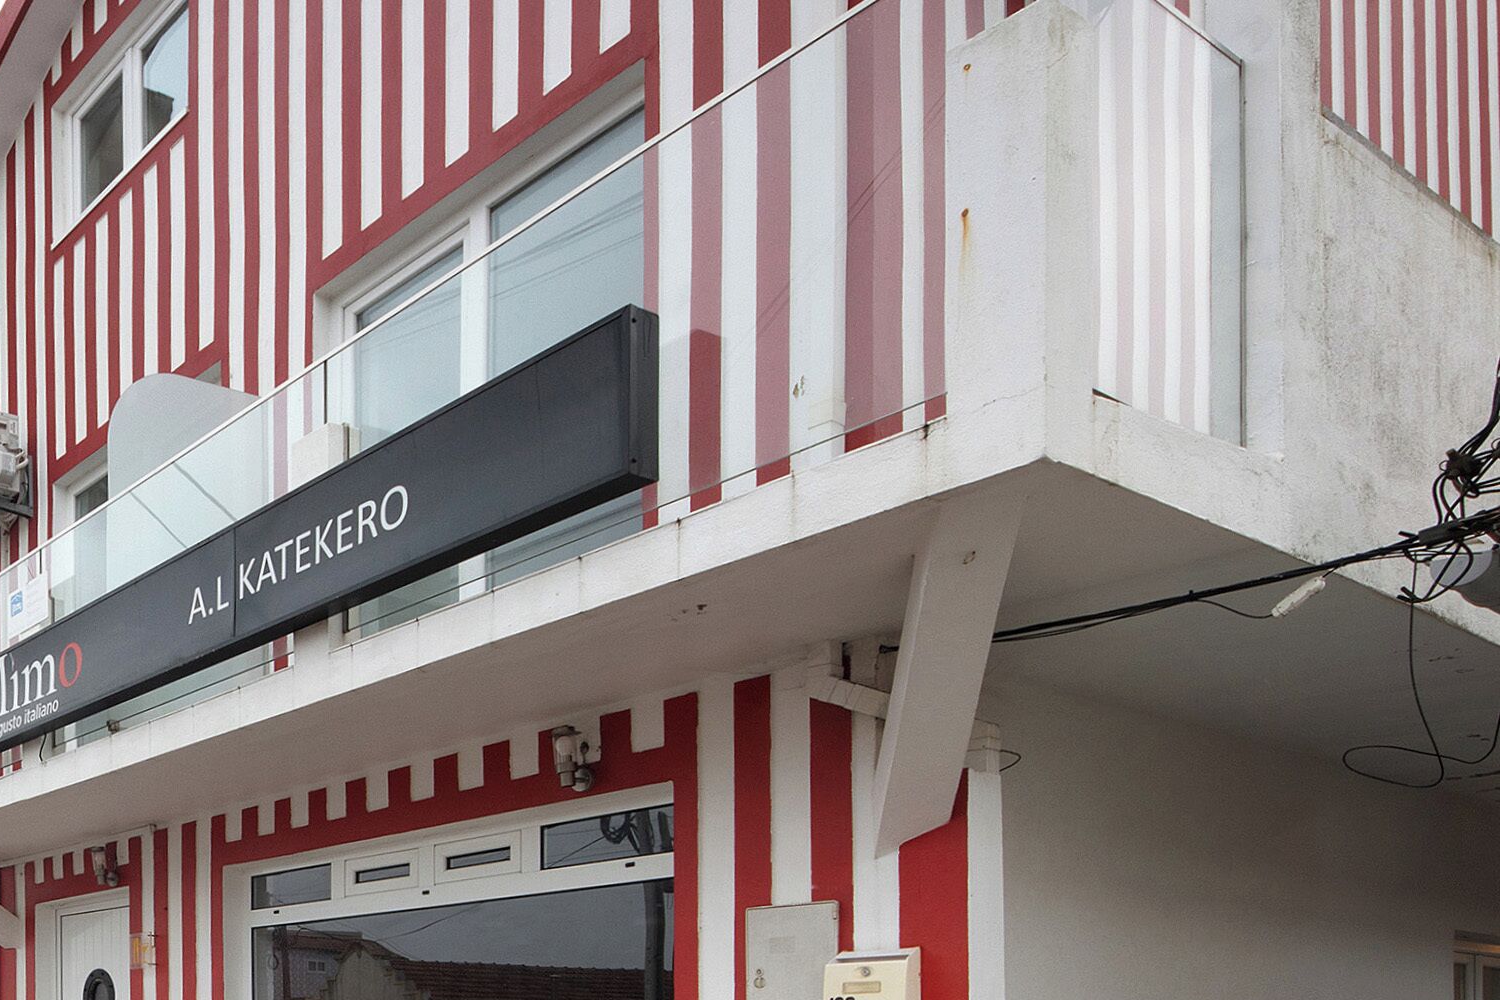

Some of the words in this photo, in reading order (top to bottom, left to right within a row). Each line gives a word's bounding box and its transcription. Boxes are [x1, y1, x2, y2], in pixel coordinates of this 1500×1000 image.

[188, 576, 230, 625] A.L
[239, 485, 409, 600] KATEKERO
[23, 699, 59, 725] italiano
